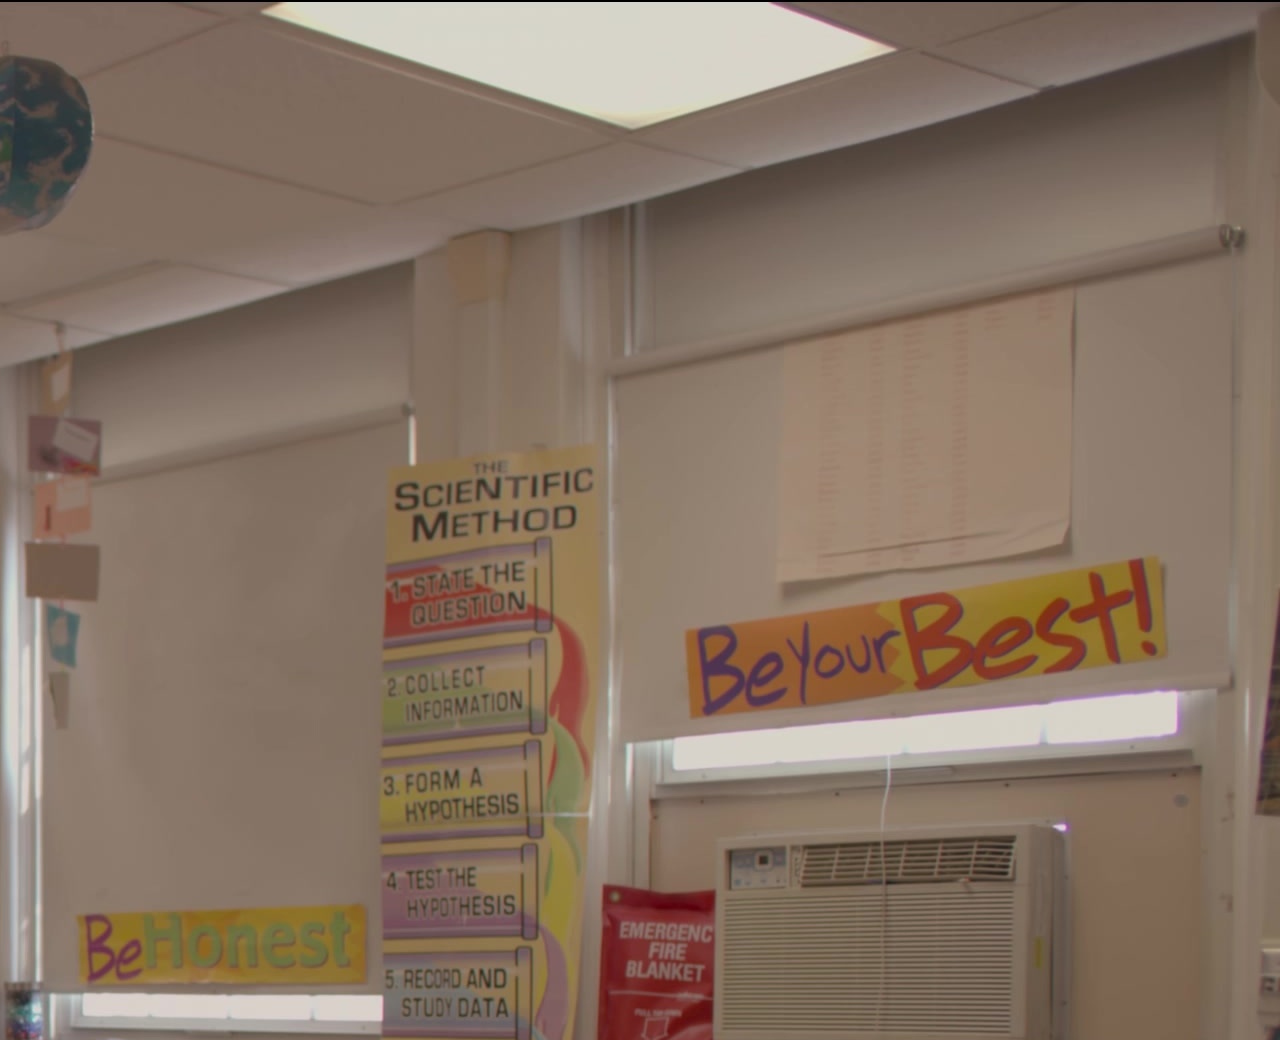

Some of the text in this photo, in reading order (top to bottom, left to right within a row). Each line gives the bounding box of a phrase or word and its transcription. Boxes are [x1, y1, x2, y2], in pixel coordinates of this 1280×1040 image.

[473, 460, 508, 475] THE
[394, 467, 594, 512] SCIENTIFIC
[411, 505, 578, 542] METHOD
[391, 561, 525, 602] 1. STATE THE
[411, 591, 527, 626] QUESTION
[697, 624, 787, 715] Be
[900, 557, 1158, 691] Best!
[387, 666, 486, 697] 2. COLLECT
[405, 690, 524, 723] INFORMATION
[384, 766, 483, 796] 3. FORM A
[404, 793, 520, 823] HYPOTHESIS
[386, 866, 477, 890] 4. TEST THE
[407, 894, 516, 918] HYPOTHESIS
[84, 911, 351, 981] Be Honest
[619, 921, 714, 943] EMERGENC
[648, 941, 688, 961] FIRE
[385, 968, 507, 990] 5. RECORD AND
[625, 960, 705, 982] BLANKET
[401, 997, 509, 1019] STUDY DATA
